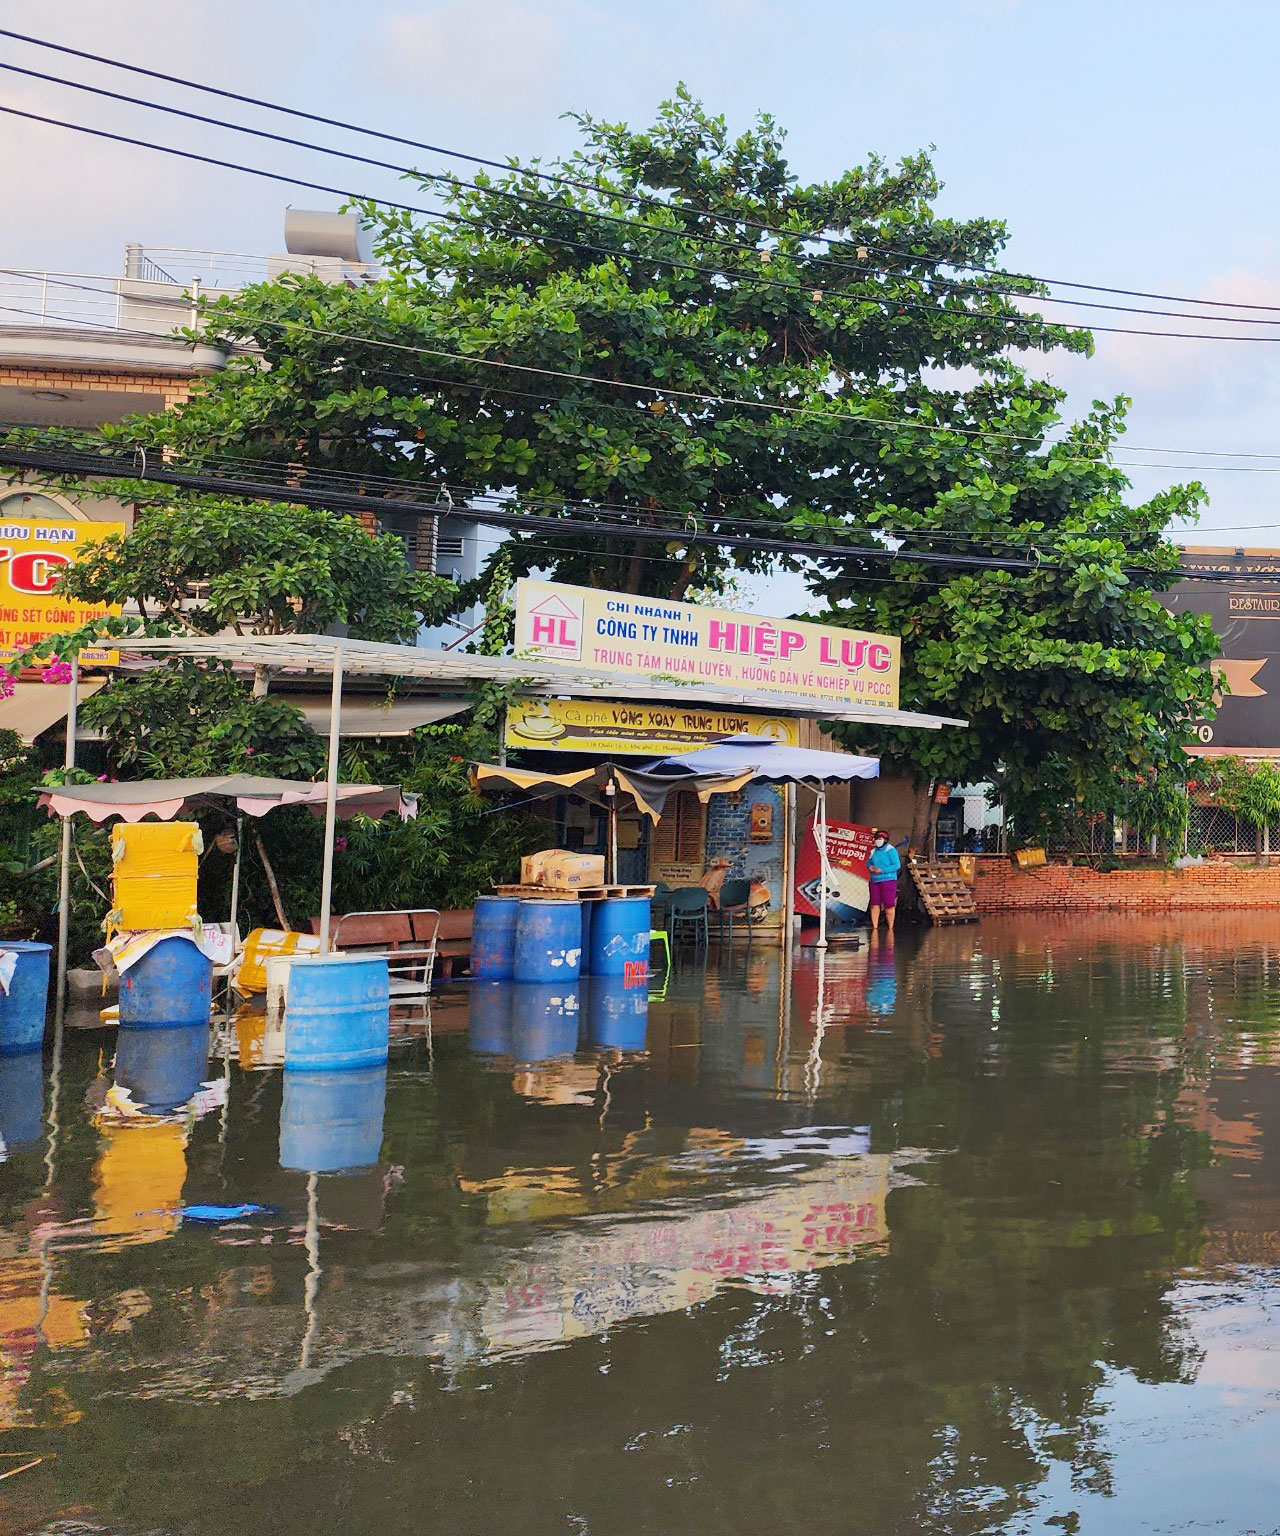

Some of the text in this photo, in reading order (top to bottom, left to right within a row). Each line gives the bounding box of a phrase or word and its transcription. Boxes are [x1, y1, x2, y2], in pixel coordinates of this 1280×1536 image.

[36, 528, 75, 543] HẠN
[45, 607, 75, 623] CÔNG
[607, 601, 691, 622] CHI NHÁNH 1
[533, 616, 577, 647] HL
[597, 616, 698, 646] CÔNG TY TNHH
[708, 620, 891, 674] HIỆP LỰC
[594, 648, 632, 667] TRUNG
[637, 652, 661, 670] TÂM
[665, 654, 695, 674] HUẤN
[700, 660, 731, 680] LUYỆN
[817, 674, 849, 693] NGHIỆP
[853, 680, 865, 695] VỤ
[868, 681, 891, 696] PCCC
[565, 709, 581, 721] Cà
[586, 712, 608, 724] phê
[612, 708, 643, 726] VÒNG
[648, 711, 677, 728] XOAY
[682, 714, 713, 731] TRUNG
[717, 717, 749, 733] LƯƠNG
[839, 847, 866, 860] Redmi
